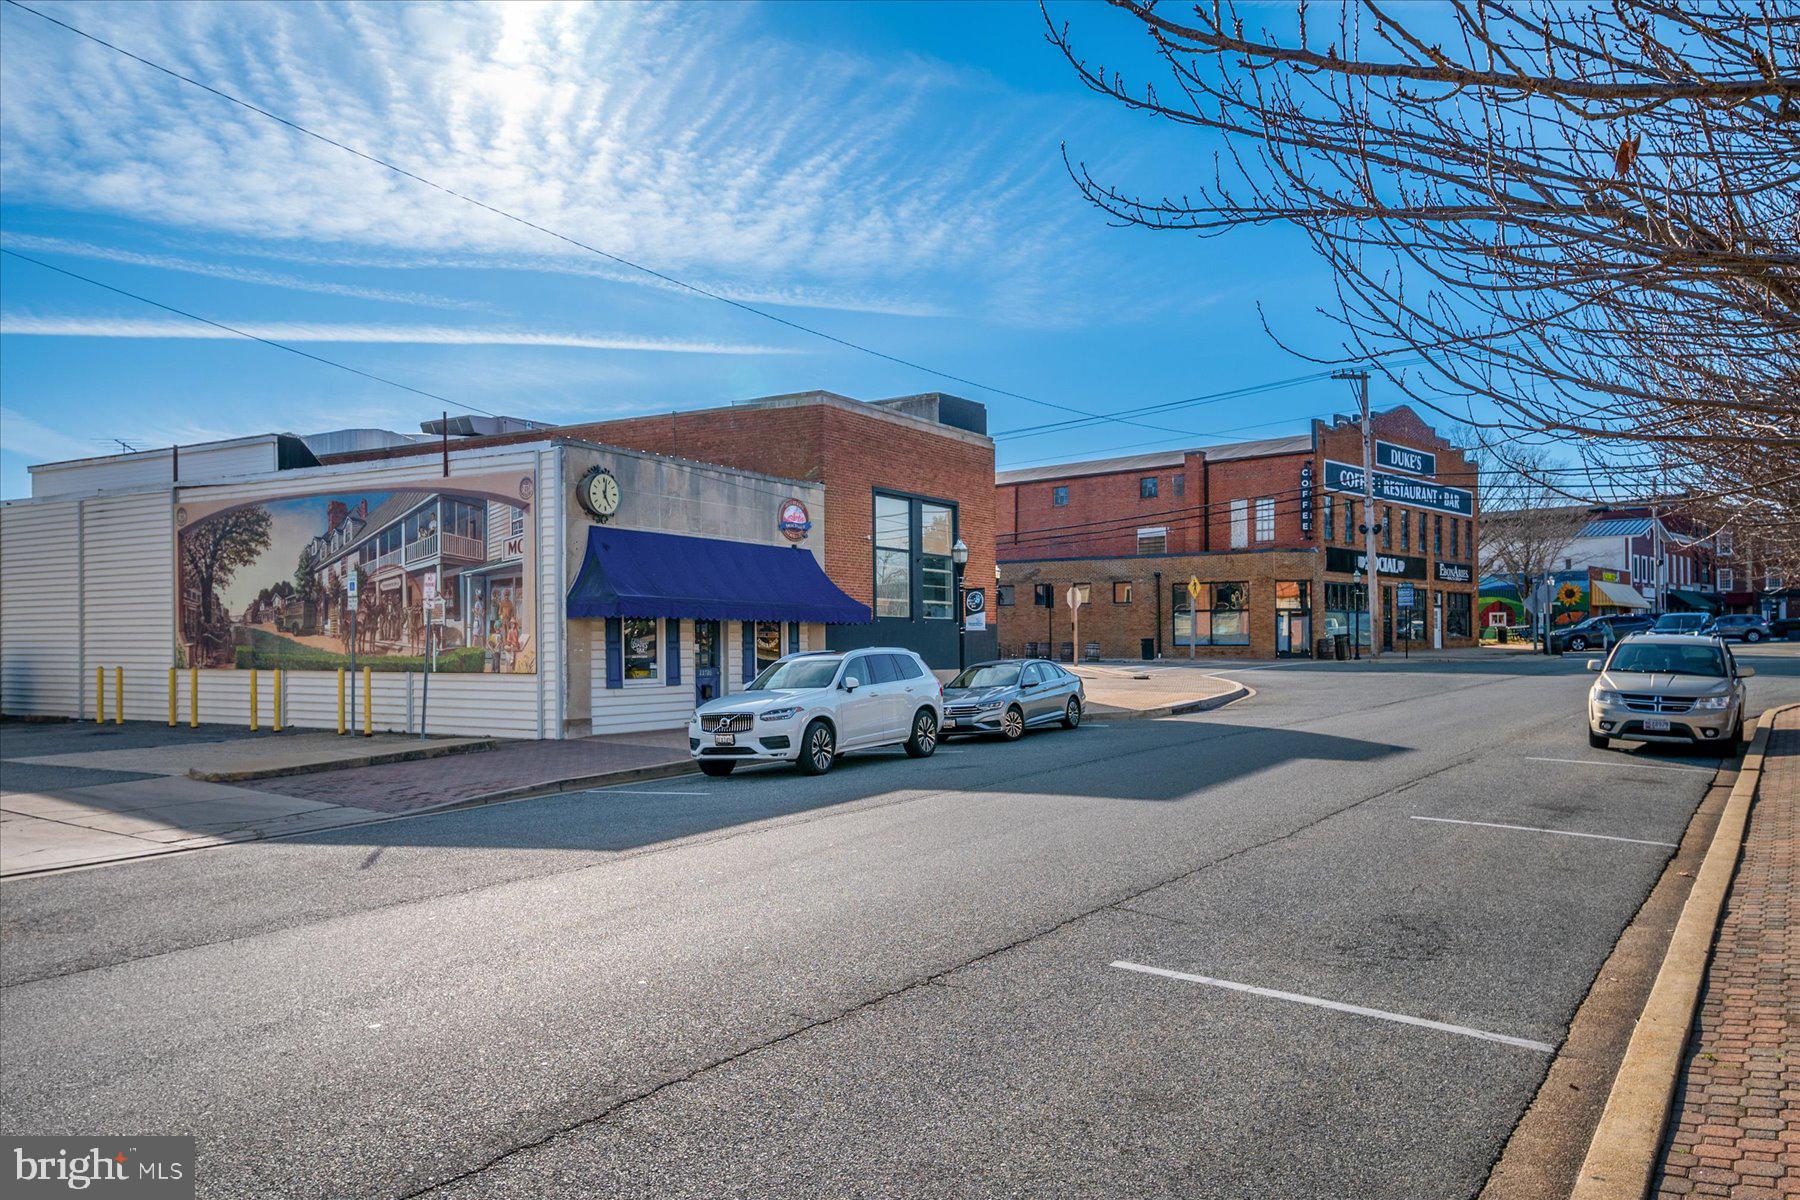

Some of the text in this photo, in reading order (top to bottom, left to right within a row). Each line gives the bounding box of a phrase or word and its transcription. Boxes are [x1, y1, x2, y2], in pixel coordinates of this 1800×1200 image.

[1390, 449, 1422, 471] DUKE'S
[1301, 468, 1309, 530] COFFEE
[1339, 470, 1460, 510] COFFE RESTAURANT BAR
